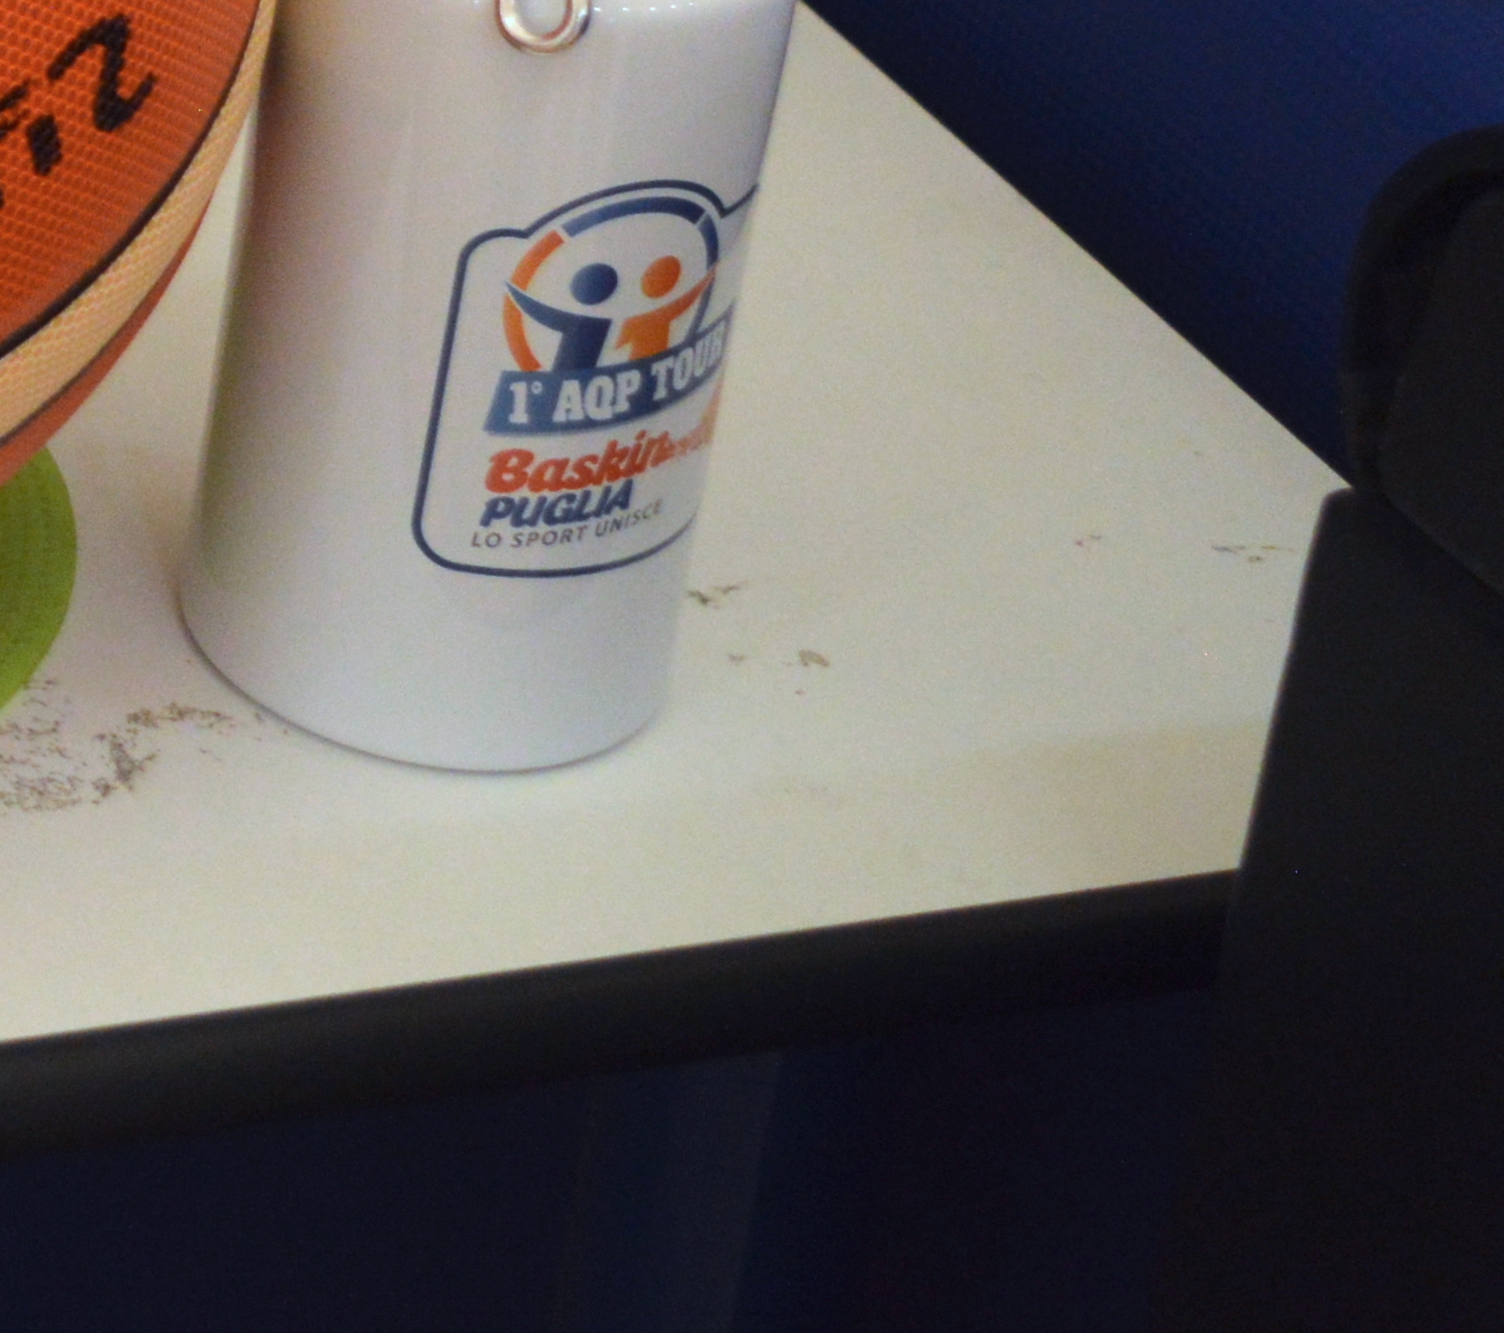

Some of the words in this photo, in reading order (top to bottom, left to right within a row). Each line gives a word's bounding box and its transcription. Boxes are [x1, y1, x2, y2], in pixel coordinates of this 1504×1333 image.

[551, 369, 642, 423] AQP
[484, 429, 676, 494] Baskin
[470, 530, 502, 549] LO
[510, 525, 588, 549] SPORT
[595, 497, 664, 538] UNISCE
[479, 478, 635, 528] PUGLIA
